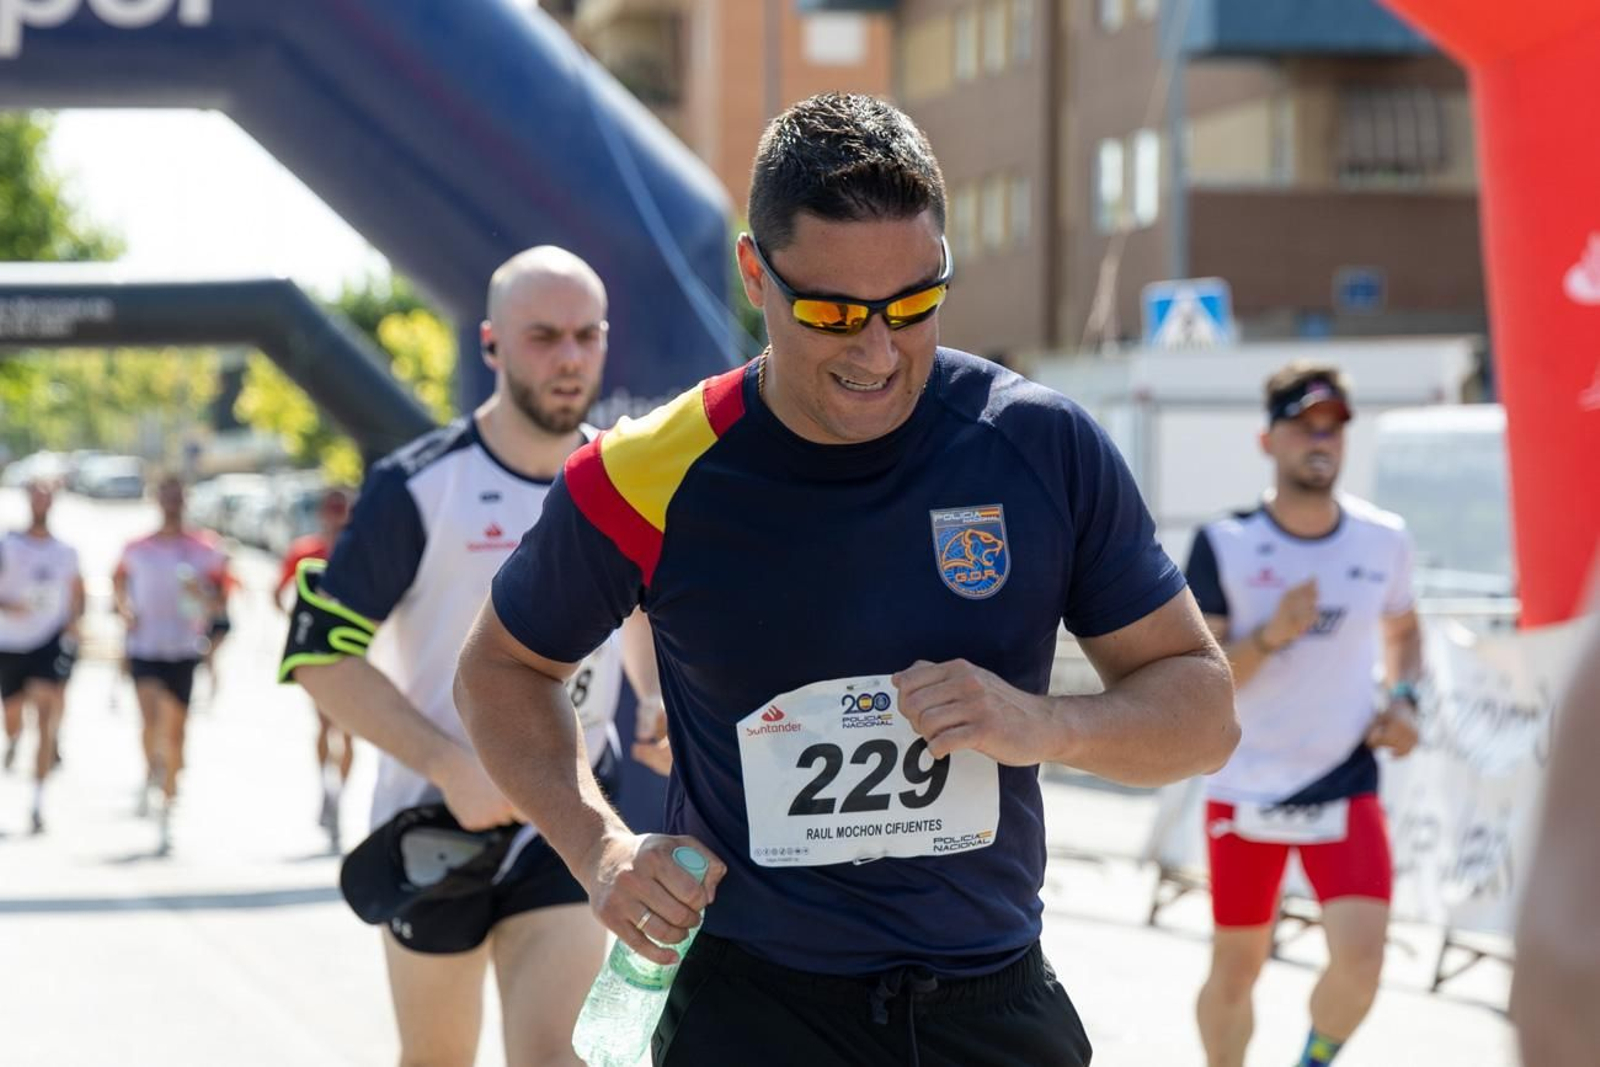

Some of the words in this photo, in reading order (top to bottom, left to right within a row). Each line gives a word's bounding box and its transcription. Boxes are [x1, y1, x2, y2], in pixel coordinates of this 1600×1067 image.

[567, 668, 592, 707] 8
[841, 691, 892, 715] 200
[842, 719, 894, 729] NACIONAL
[787, 738, 951, 817] 229
[806, 827, 833, 841] RAUL
[836, 823, 882, 838] MOCHON
[885, 818, 943, 835] CIFUENTES
[933, 833, 982, 845] POLICIA
[933, 838, 991, 852] NACIONAL
